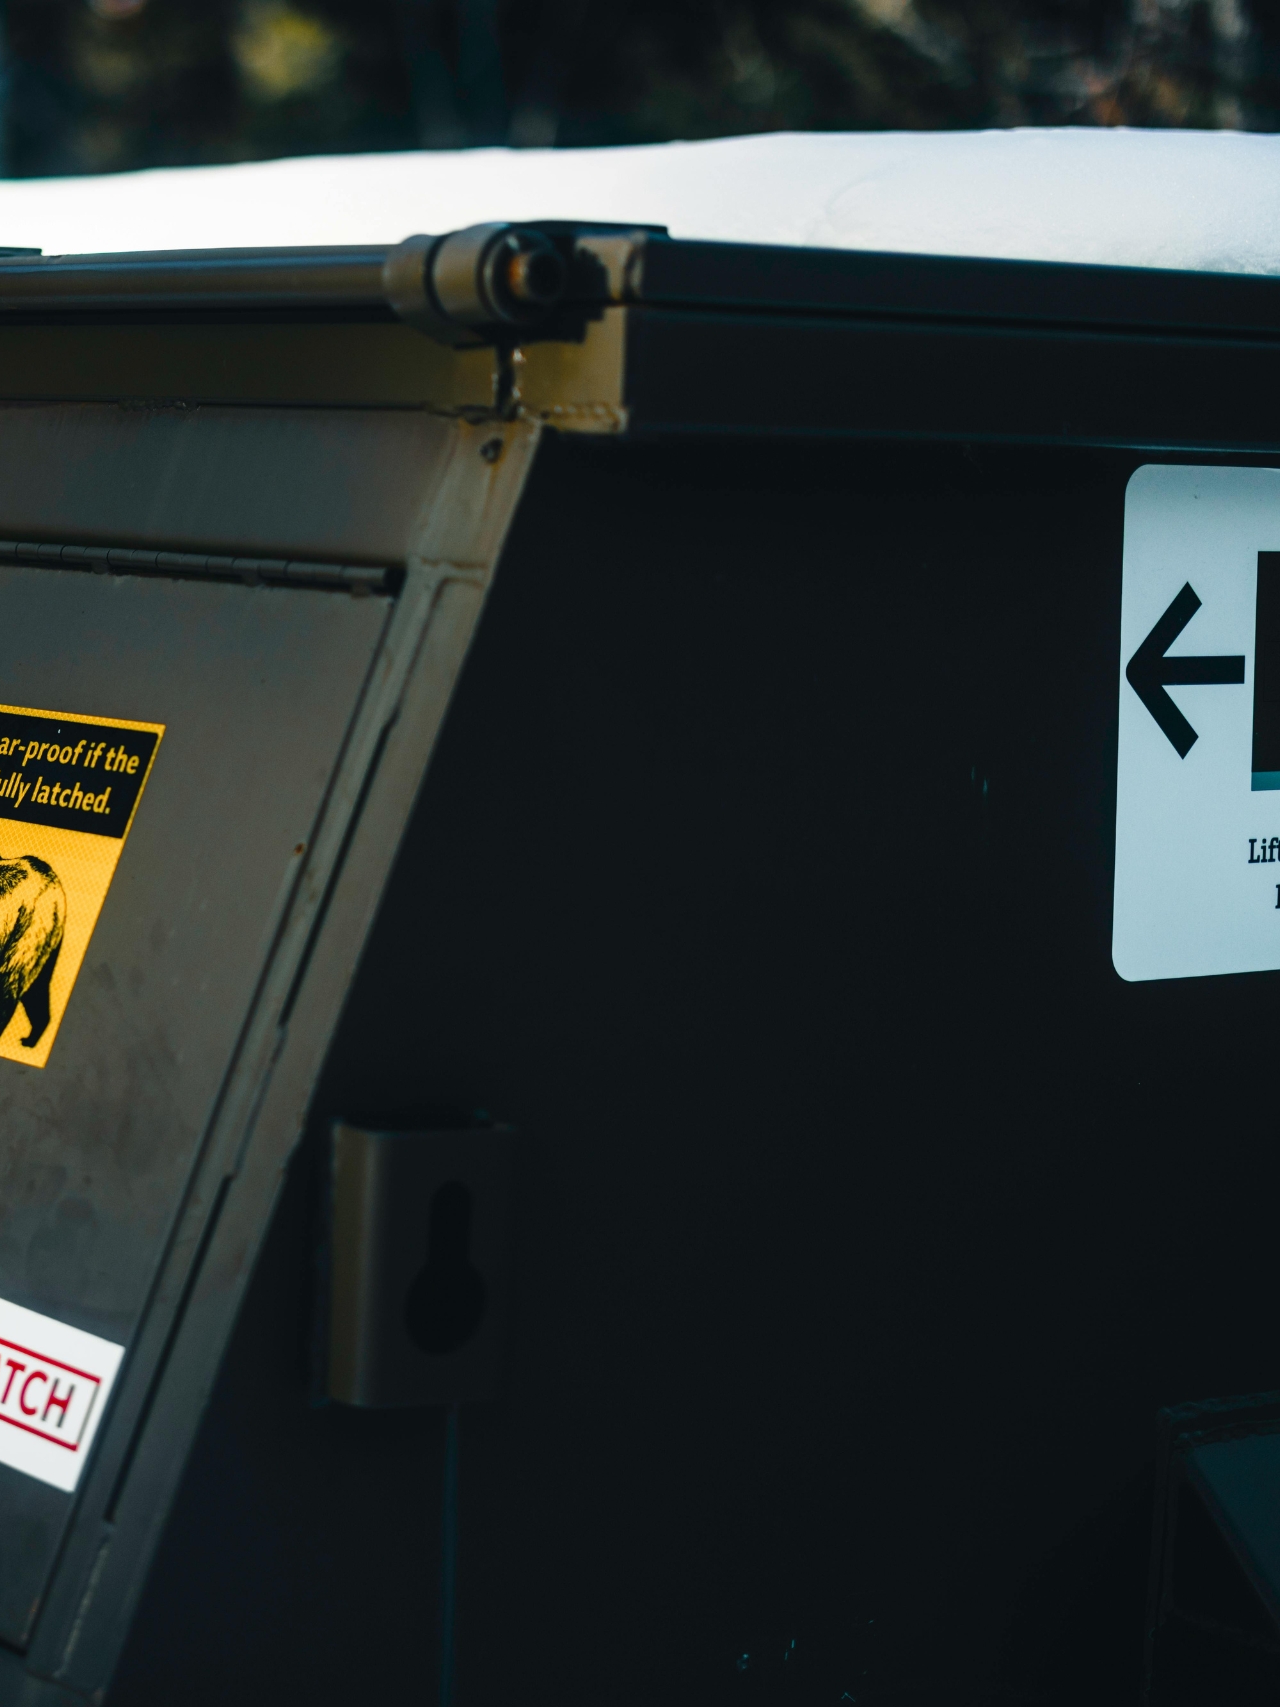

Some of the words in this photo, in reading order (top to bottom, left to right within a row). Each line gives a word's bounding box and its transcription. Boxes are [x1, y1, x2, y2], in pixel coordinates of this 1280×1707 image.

[83, 741, 104, 769] if
[105, 745, 140, 775] the
[31, 776, 112, 814] latched.
